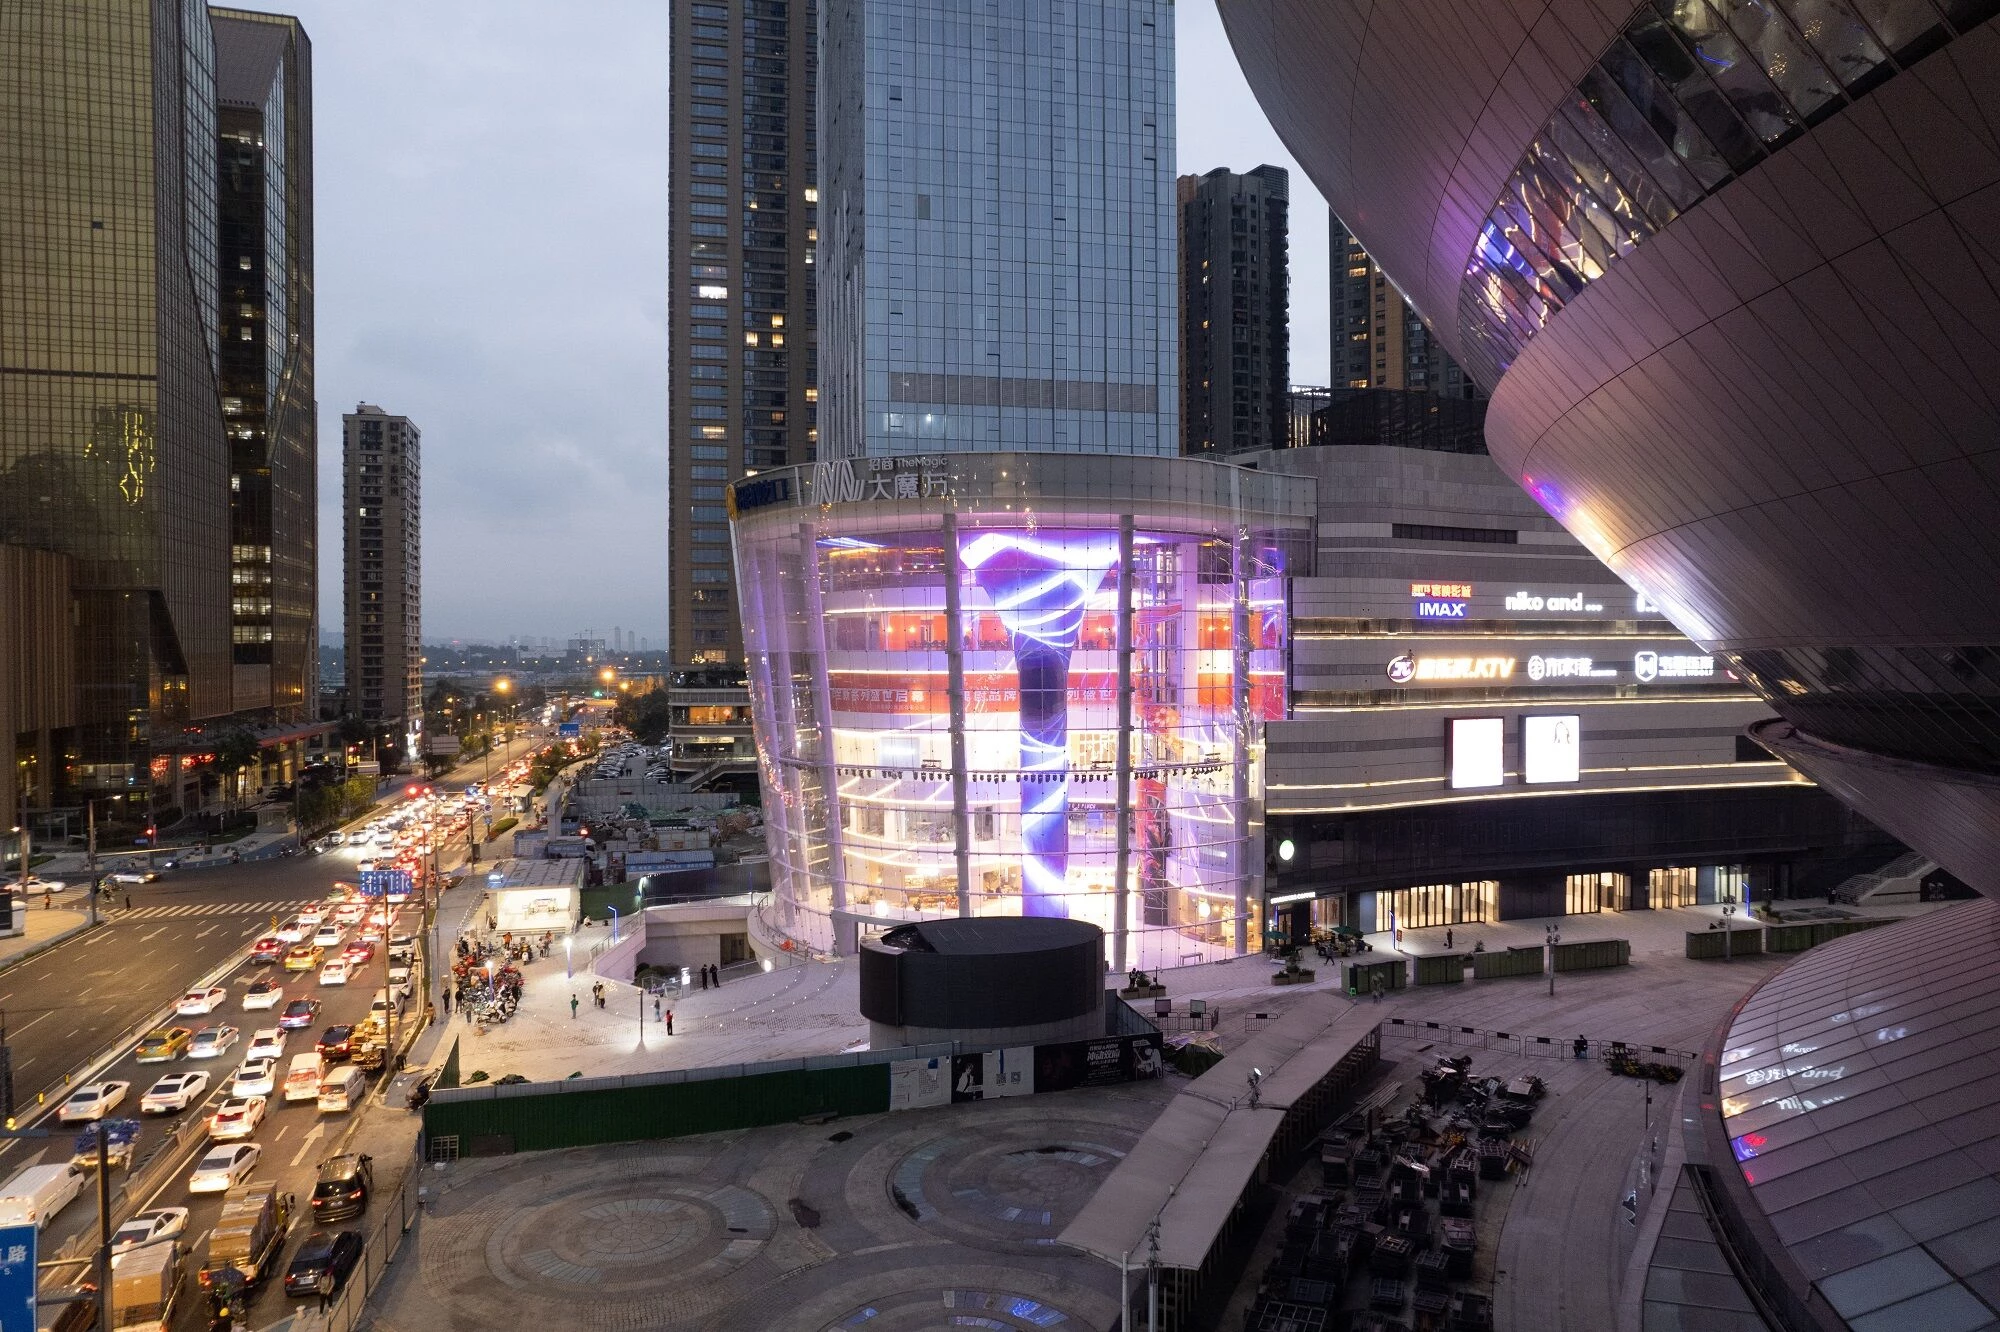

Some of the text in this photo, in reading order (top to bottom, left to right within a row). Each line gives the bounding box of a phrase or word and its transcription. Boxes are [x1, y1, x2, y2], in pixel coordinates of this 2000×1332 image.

[869, 457, 948, 471] 招商 TheMagic
[868, 471, 949, 501] 大魔方
[1506, 592, 1544, 610] niko
[1547, 592, 1583, 611] and
[1420, 603, 1465, 617] IMAX
